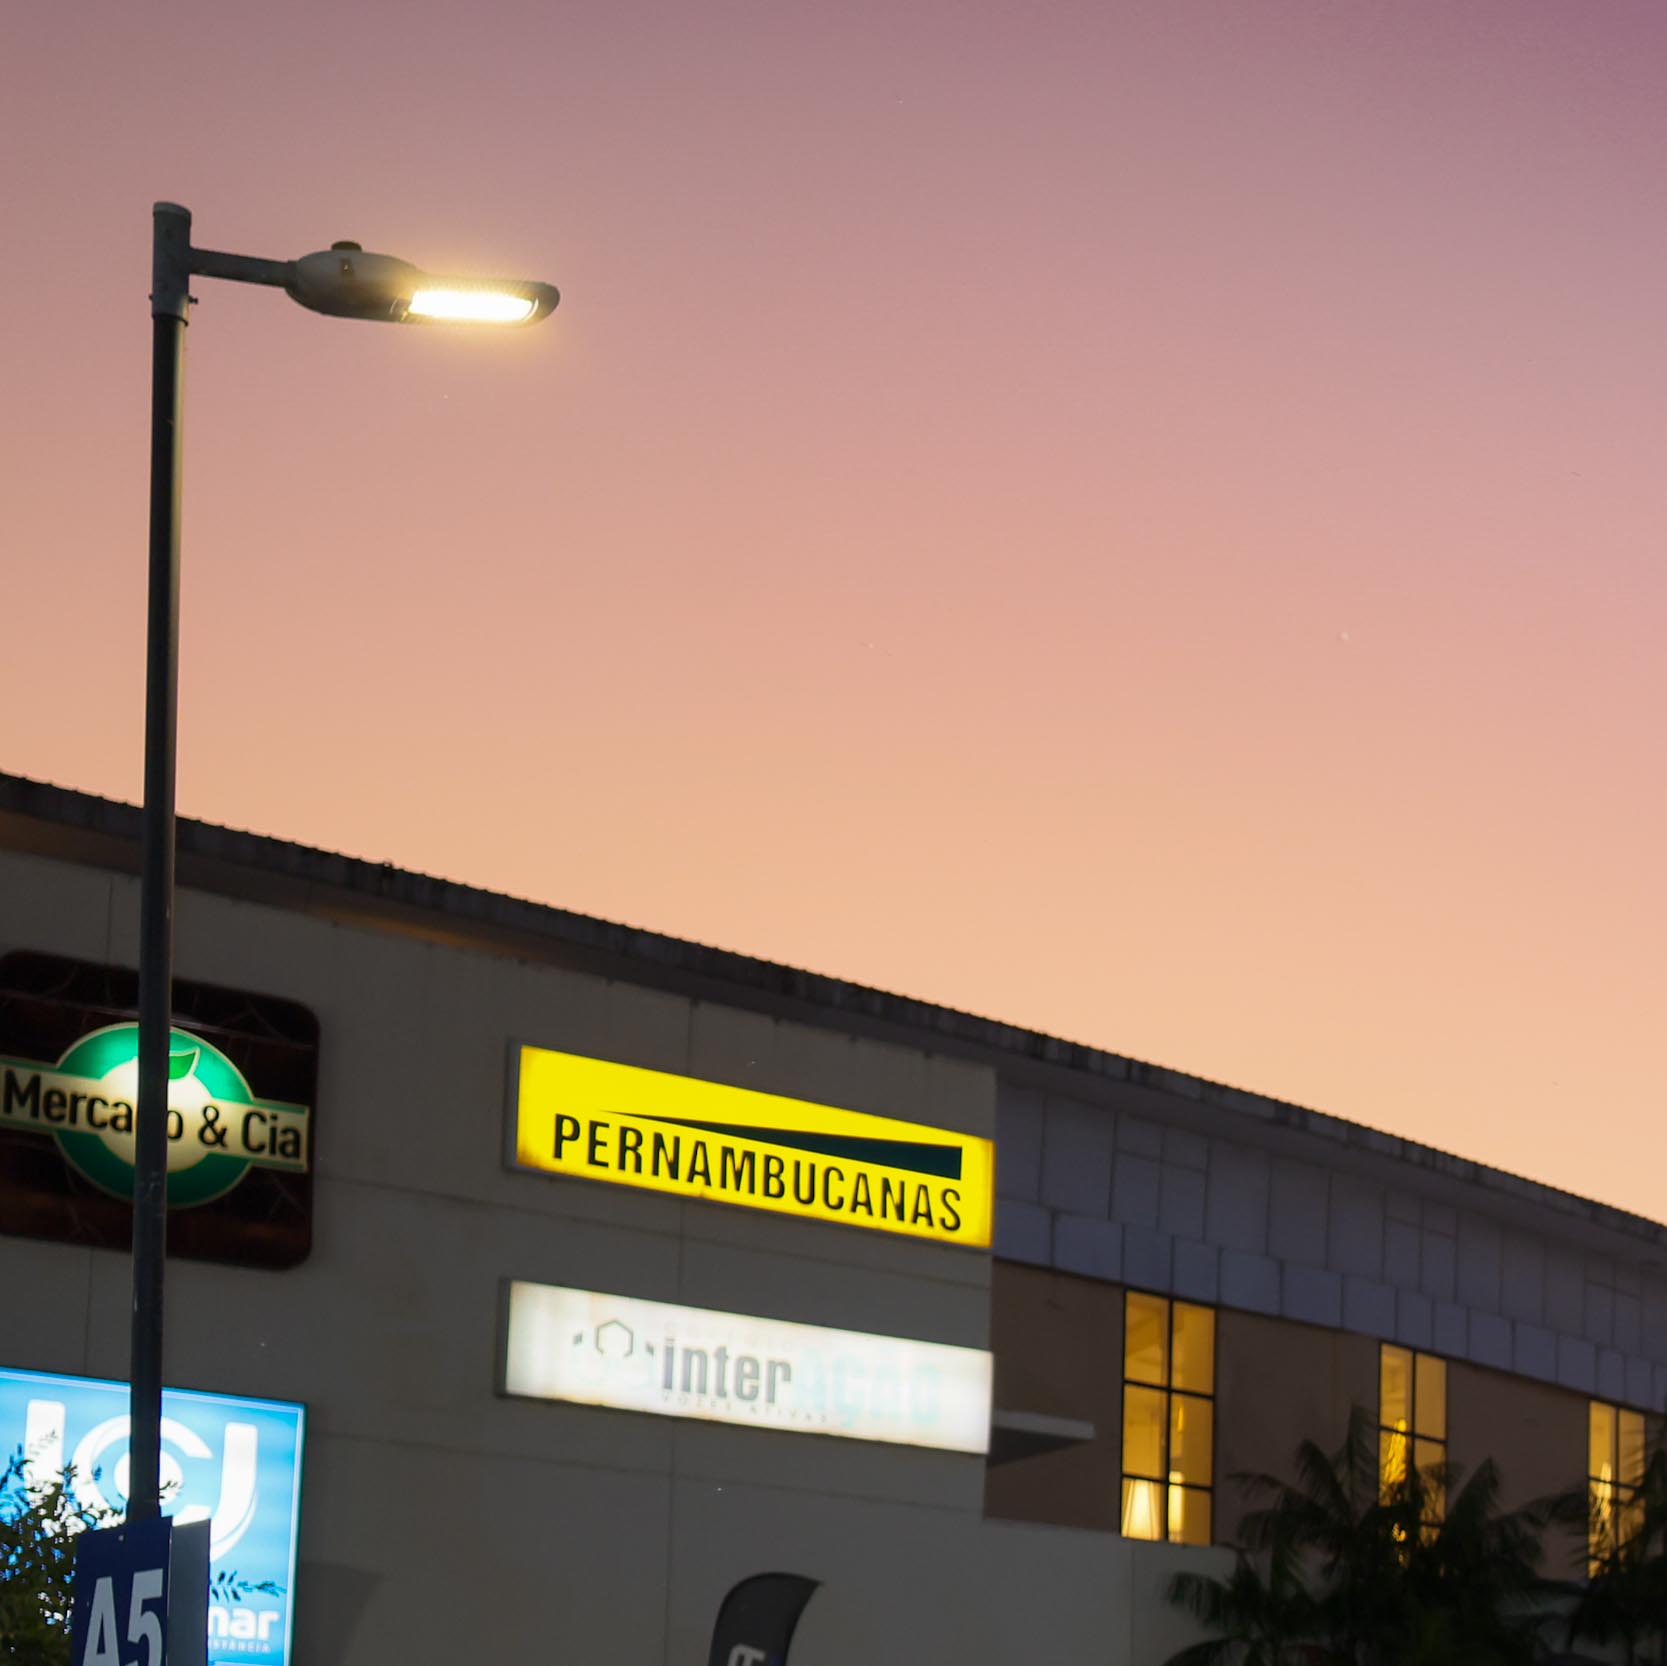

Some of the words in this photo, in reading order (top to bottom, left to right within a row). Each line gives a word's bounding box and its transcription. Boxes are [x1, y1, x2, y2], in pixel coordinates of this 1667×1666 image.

[3, 1069, 184, 1140] Mercao
[198, 1104, 228, 1148] &
[242, 1111, 301, 1159] Cia
[553, 1112, 962, 1232] PERNAMBUCANAS
